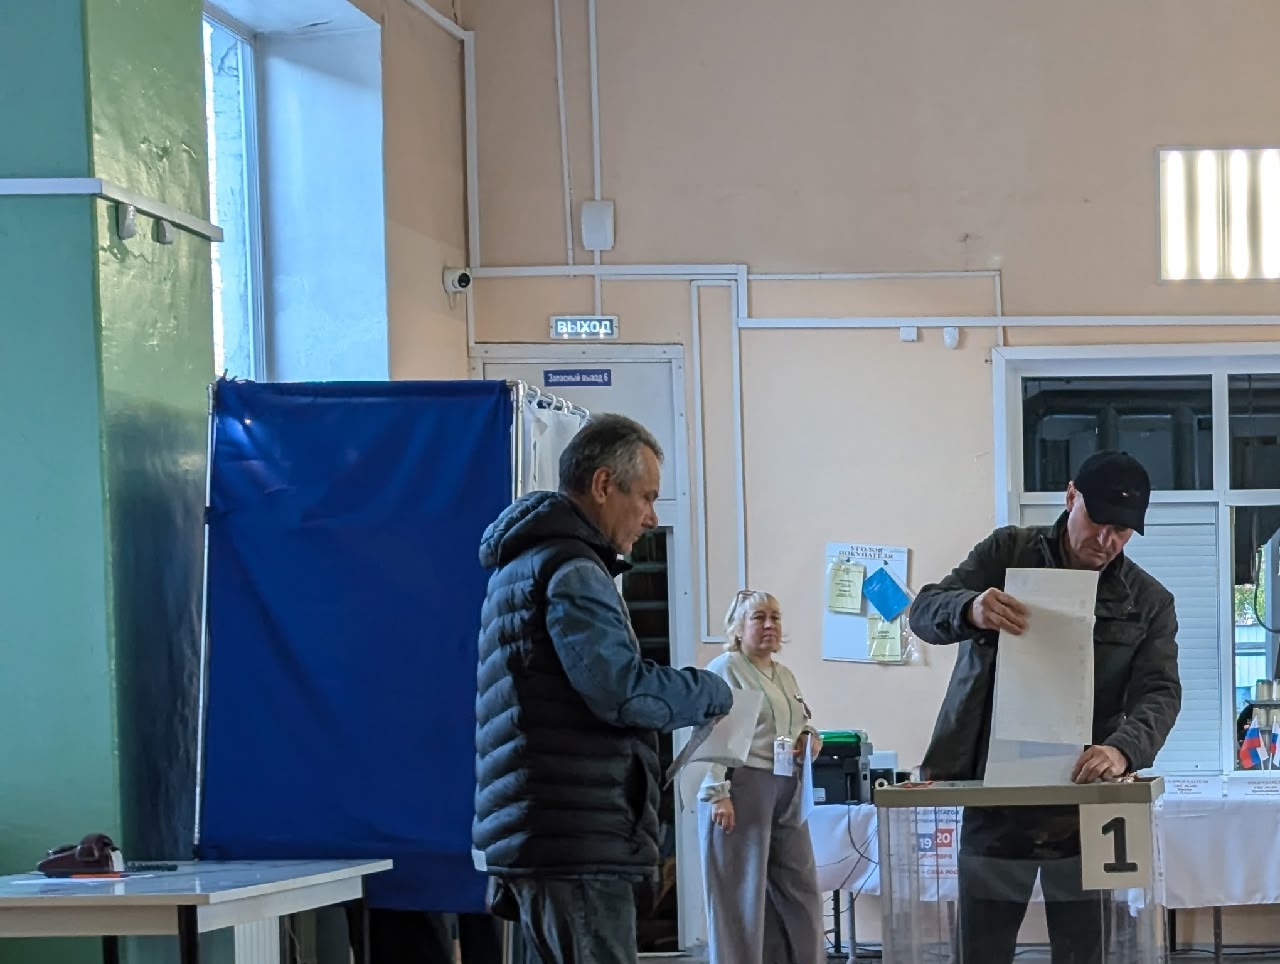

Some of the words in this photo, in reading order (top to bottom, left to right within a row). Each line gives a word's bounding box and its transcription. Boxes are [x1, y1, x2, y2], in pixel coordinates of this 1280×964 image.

[557, 321, 611, 334] ВЫХОД
[919, 838, 932, 849] 19
[935, 833, 951, 844] 20
[1101, 816, 1138, 873] 1
